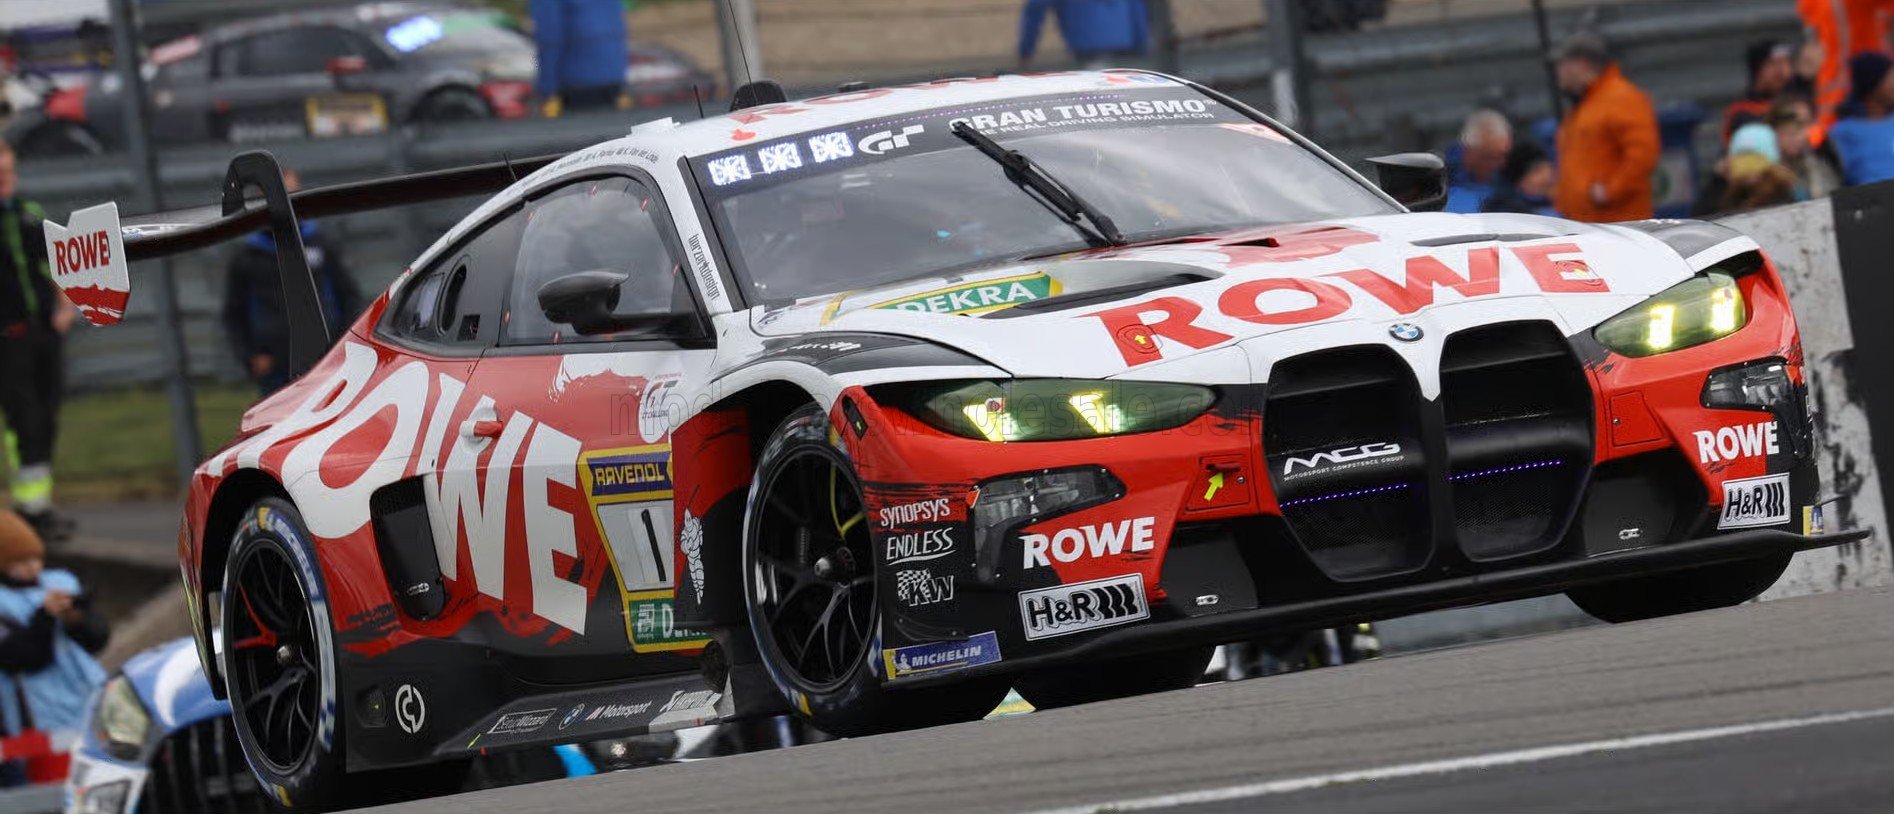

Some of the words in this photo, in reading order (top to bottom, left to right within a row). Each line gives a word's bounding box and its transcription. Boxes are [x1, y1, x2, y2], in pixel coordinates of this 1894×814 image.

[1048, 115, 1117, 127] DRIVING
[1120, 112, 1215, 122] SIMULATOR
[53, 230, 110, 276] ROWE
[896, 281, 1037, 313] DEKRA
[1080, 243, 1610, 367] ROWE
[1692, 420, 1780, 464] ROWE
[595, 463, 665, 486] RAVENOL
[1284, 467, 1330, 481] MOTORSPORT
[1332, 459, 1379, 472] COMPETENCE
[1381, 455, 1404, 464] GROUP
[203, 341, 587, 636] ROWE
[1725, 486, 1764, 519] H&R
[879, 498, 951, 529] SYNOPSYS
[641, 508, 667, 582] 1
[886, 527, 954, 561] ENDLESS
[1018, 517, 1155, 570] ROWE
[905, 573, 954, 607] KW
[1027, 592, 1097, 628] H&R
[911, 645, 982, 668] MICHELIN
